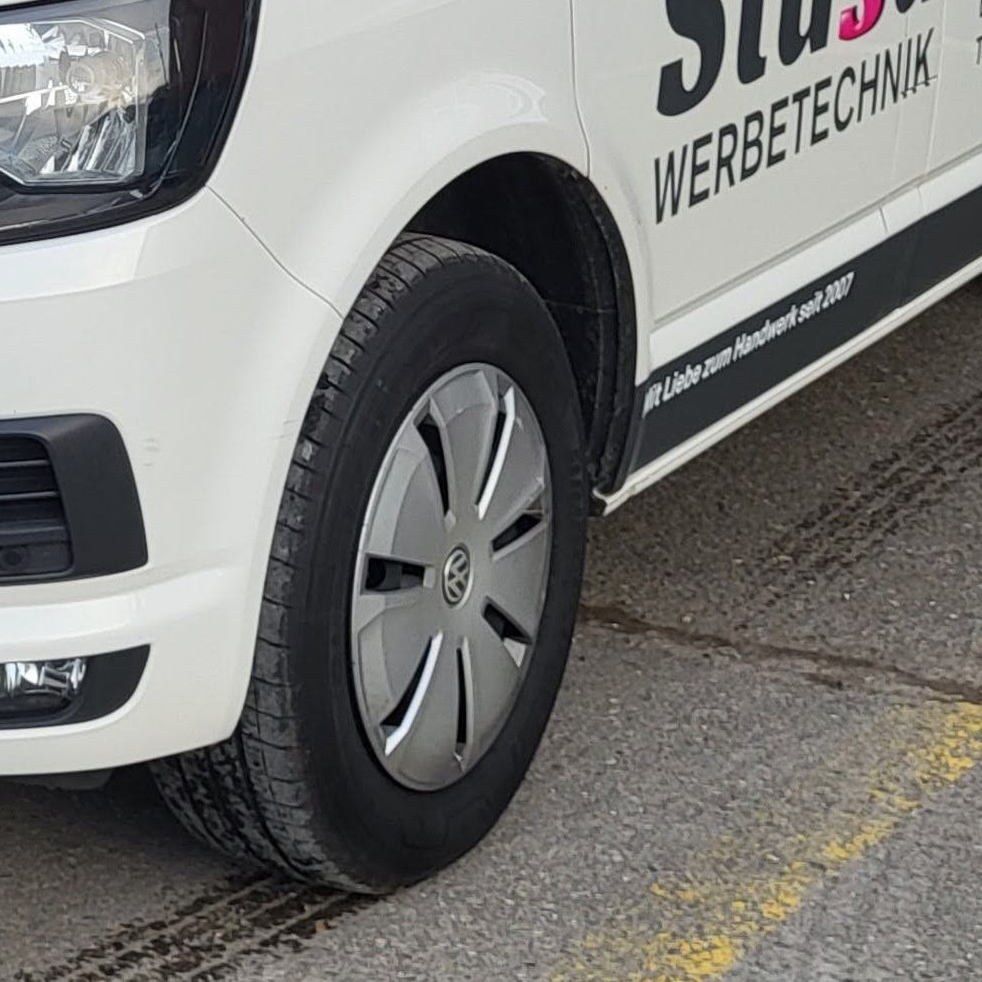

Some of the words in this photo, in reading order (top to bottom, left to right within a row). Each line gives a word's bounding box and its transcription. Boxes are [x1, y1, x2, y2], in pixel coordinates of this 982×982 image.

[653, 27, 936, 225] WERBETECHNIK
[662, 364, 702, 403] Liebe
[701, 346, 733, 380] zum
[732, 304, 799, 363] Handwerk
[797, 289, 823, 324] seit
[821, 271, 855, 309] 2007
